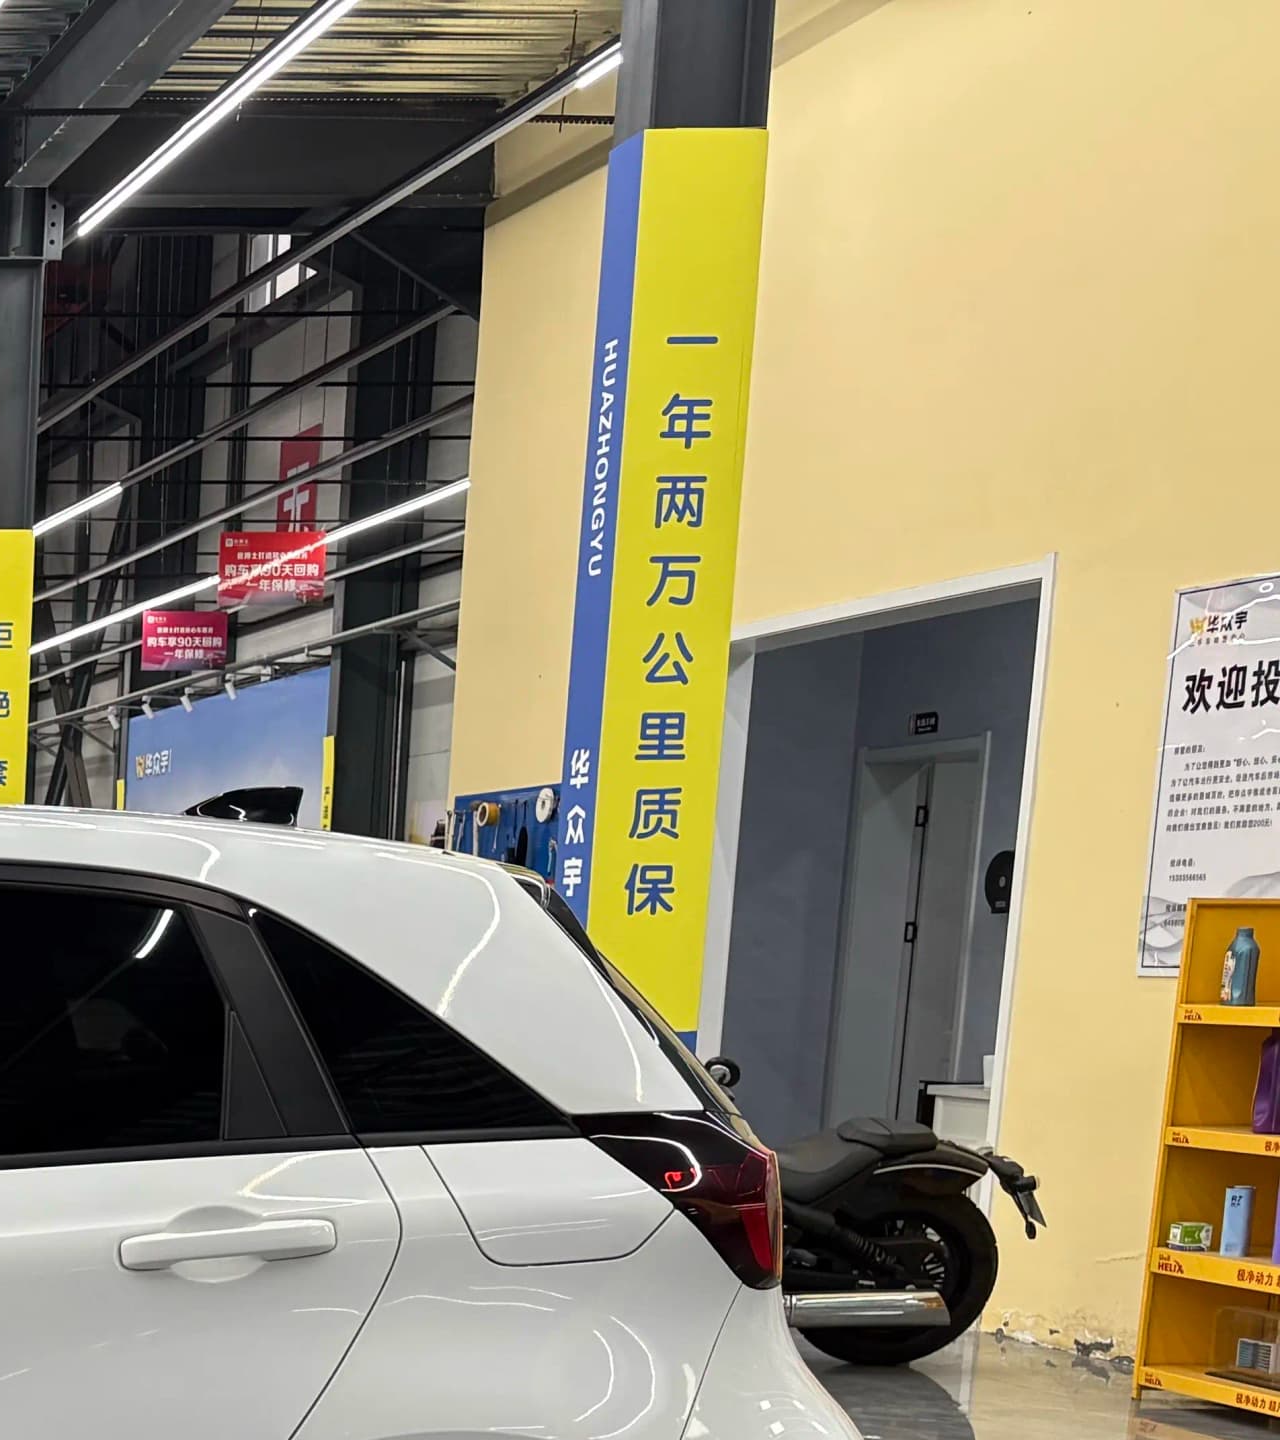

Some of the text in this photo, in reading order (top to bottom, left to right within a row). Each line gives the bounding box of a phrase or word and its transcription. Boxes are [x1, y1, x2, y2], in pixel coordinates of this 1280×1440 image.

[588, 338, 619, 577] HUAZHONGYU
[146, 636, 223, 648] 购车享90天回购
[623, 336, 719, 916] 一年两万公里质保
[1182, 659, 1280, 714] 欢迎投
[562, 748, 591, 898] 华众宇
[1158, 1260, 1184, 1275] HELIX
